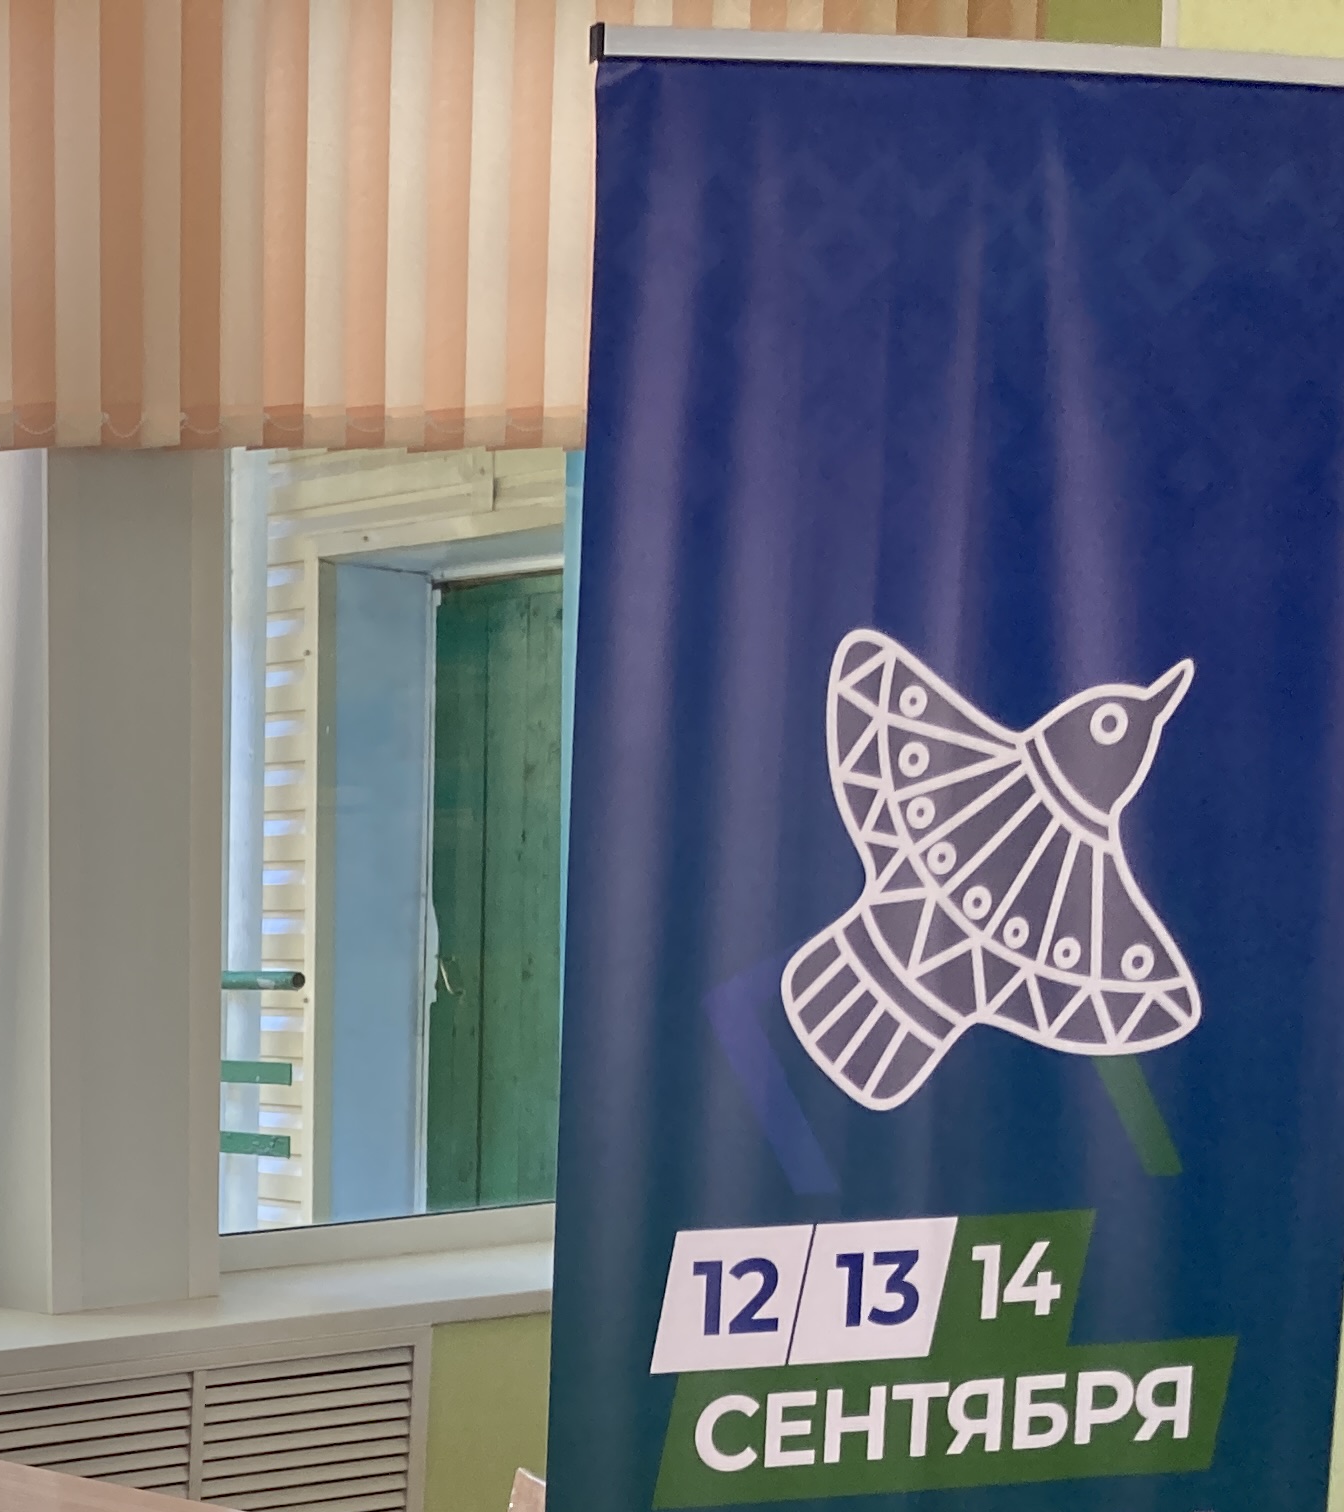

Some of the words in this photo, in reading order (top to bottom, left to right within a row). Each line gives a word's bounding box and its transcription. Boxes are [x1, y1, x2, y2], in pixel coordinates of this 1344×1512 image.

[692, 1257, 780, 1337] 12
[835, 1248, 921, 1328] 13
[970, 1240, 1062, 1321] 14
[693, 1364, 1193, 1472] СЕНТЯБРЯ
